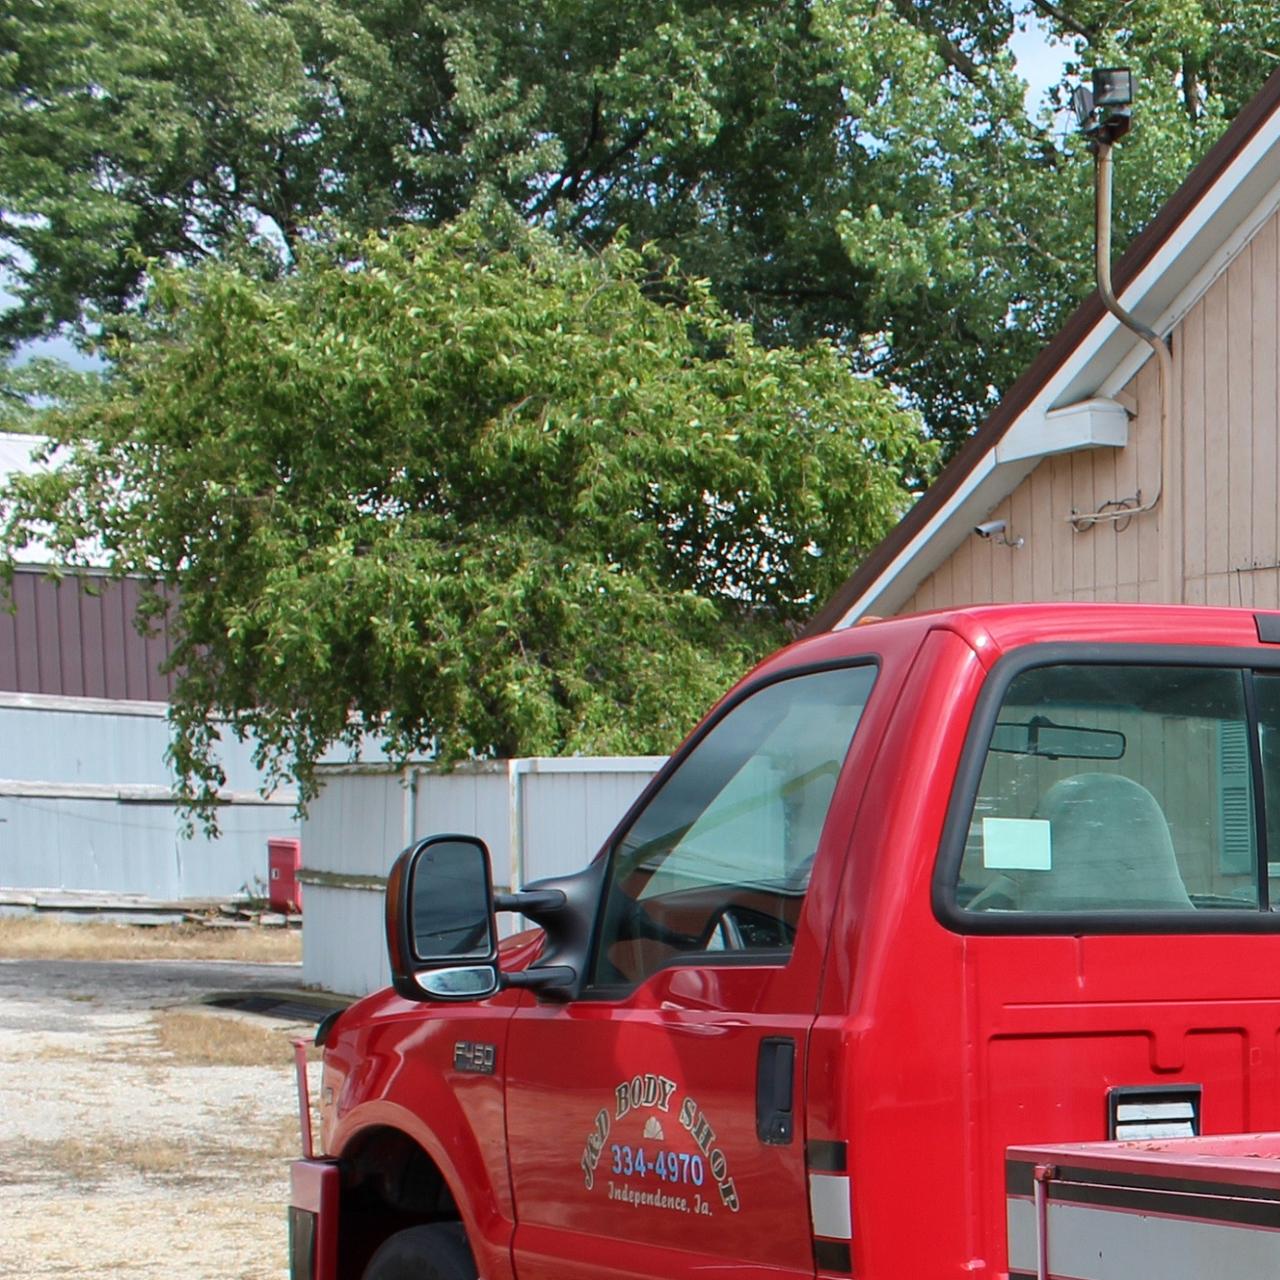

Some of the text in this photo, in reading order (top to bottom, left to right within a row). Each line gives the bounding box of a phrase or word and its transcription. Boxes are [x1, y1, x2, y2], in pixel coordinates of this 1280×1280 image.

[581, 1073, 740, 1212] J&D BODY SHOP
[611, 1144, 704, 1186] 334-4970
[608, 1181, 690, 1213] Independence,
